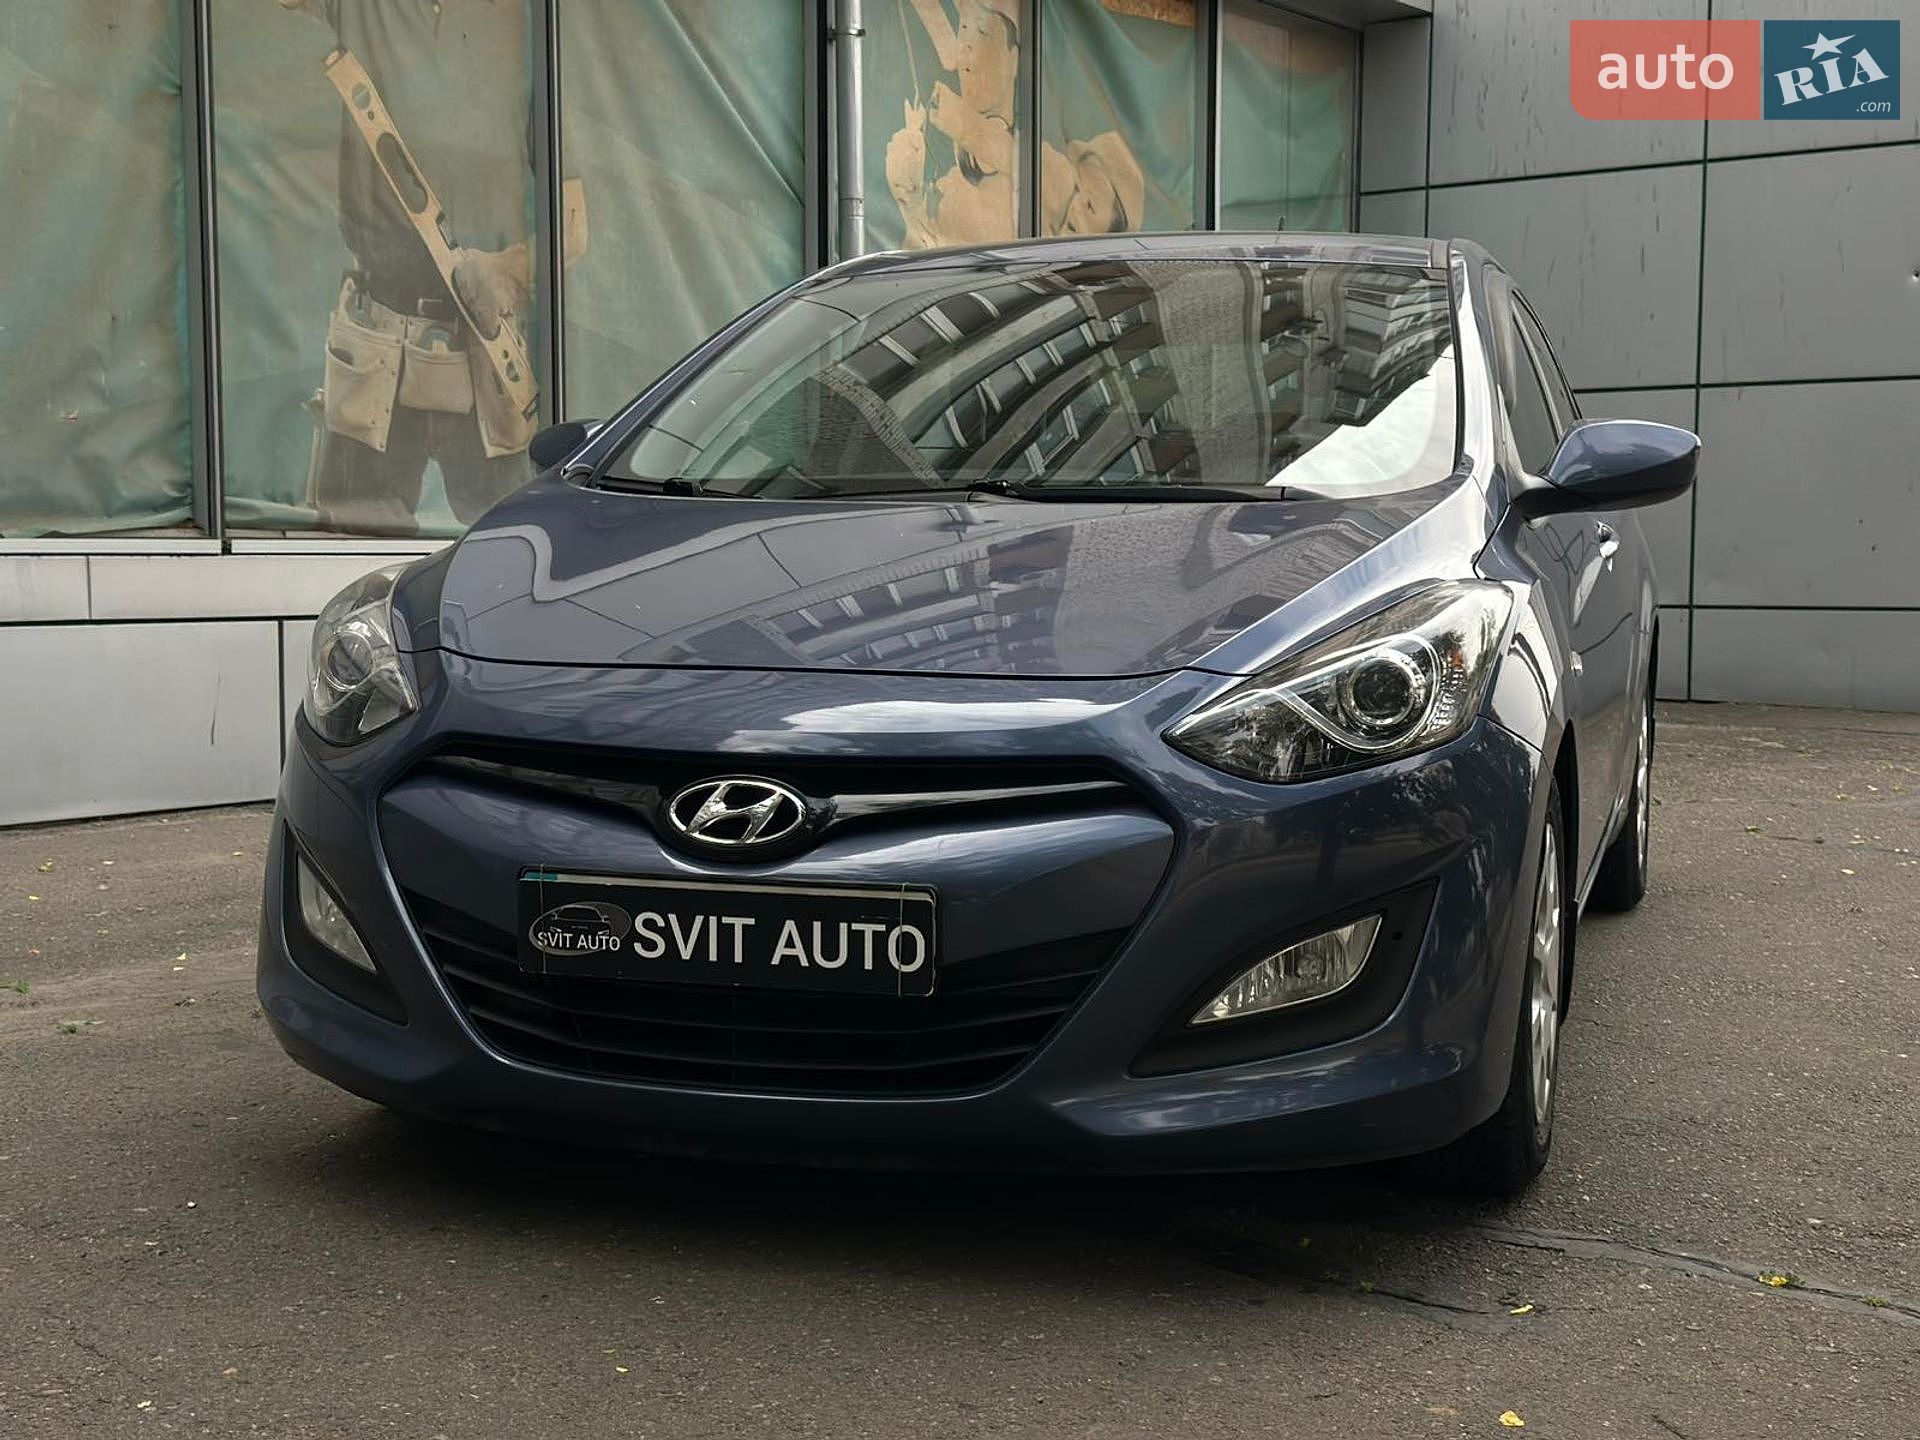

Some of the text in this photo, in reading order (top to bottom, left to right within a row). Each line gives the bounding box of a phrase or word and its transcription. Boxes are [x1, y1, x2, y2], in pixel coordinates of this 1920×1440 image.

[537, 931, 621, 951] SVIT AUTO
[632, 911, 926, 973] SVIT AUTO
